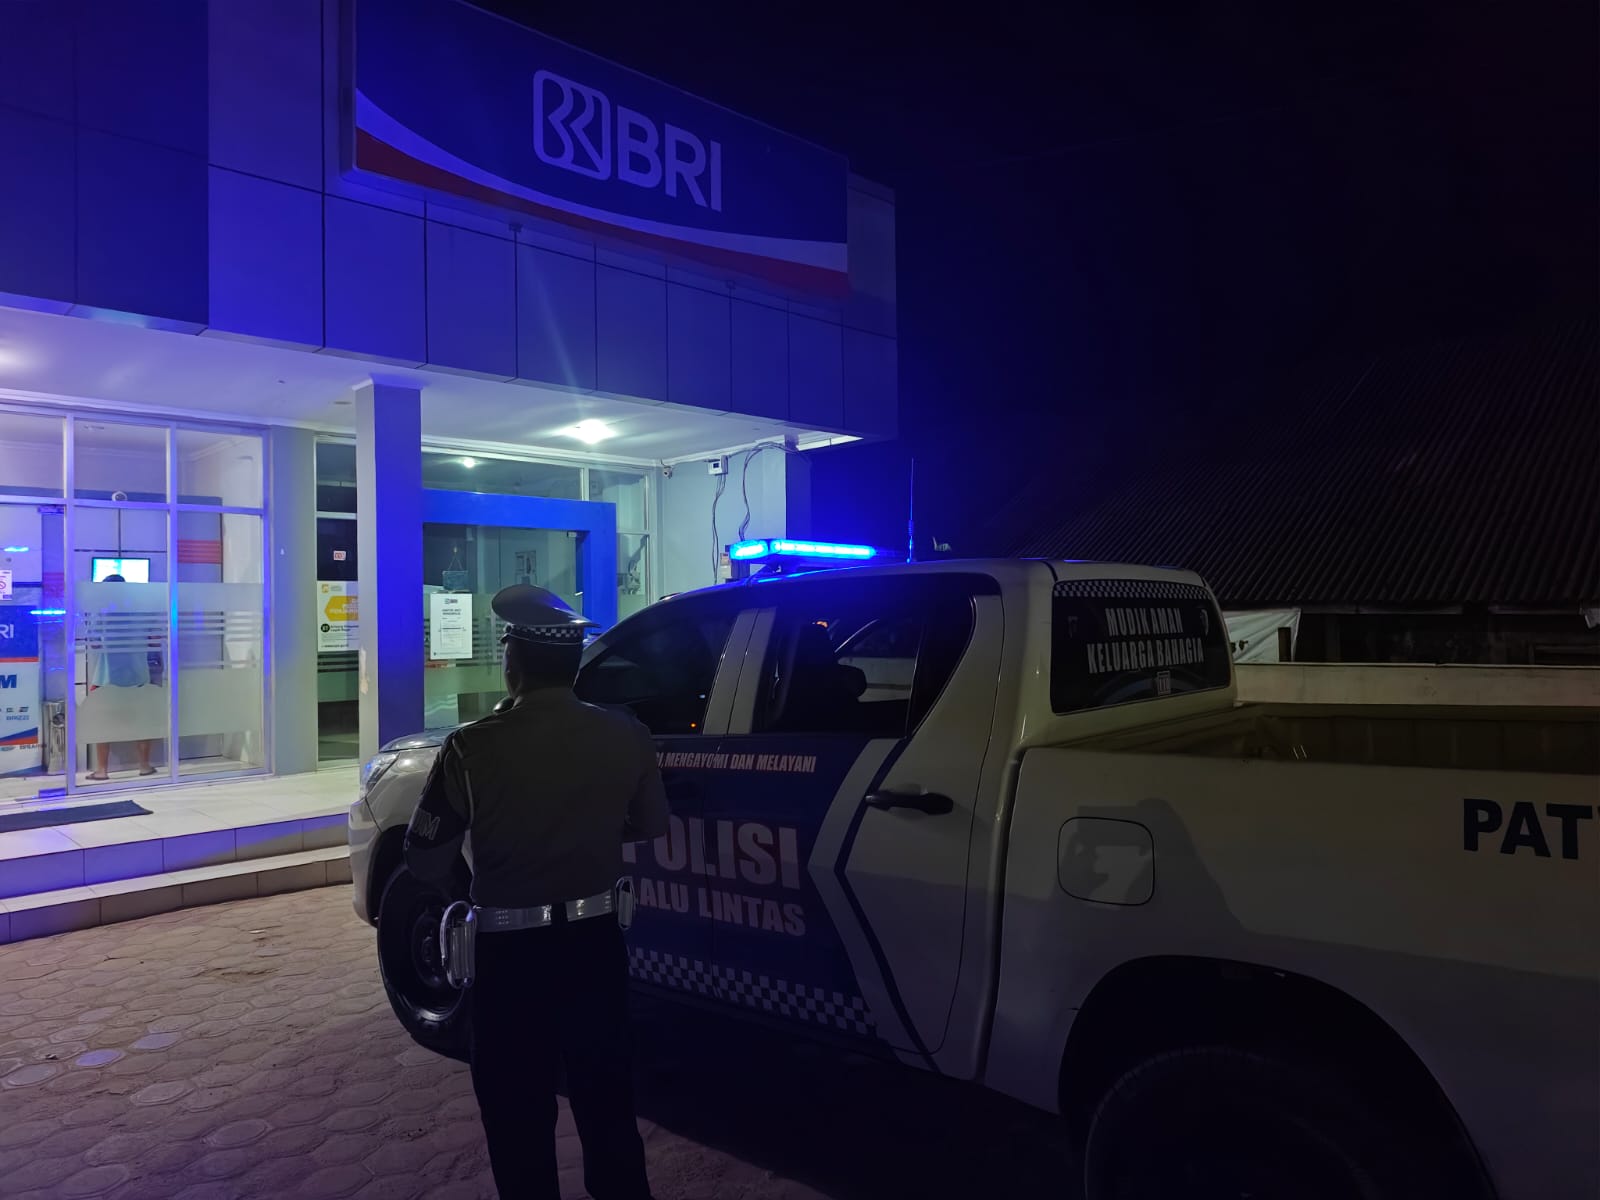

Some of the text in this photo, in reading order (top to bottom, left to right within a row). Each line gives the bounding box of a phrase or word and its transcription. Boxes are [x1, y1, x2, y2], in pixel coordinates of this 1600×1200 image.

[617, 105, 722, 212] BRI
[0, 623, 14, 638] RI
[1105, 607, 1184, 637] MUDIK AMAN
[1087, 639, 1155, 674] KELUARGA
[1157, 638, 1205, 666] BAHAGIA
[729, 753, 755, 771] DAN
[756, 755, 817, 773] MELAYANI
[1463, 798, 1600, 860] PAT
[639, 877, 806, 937] ALU LINTAS
